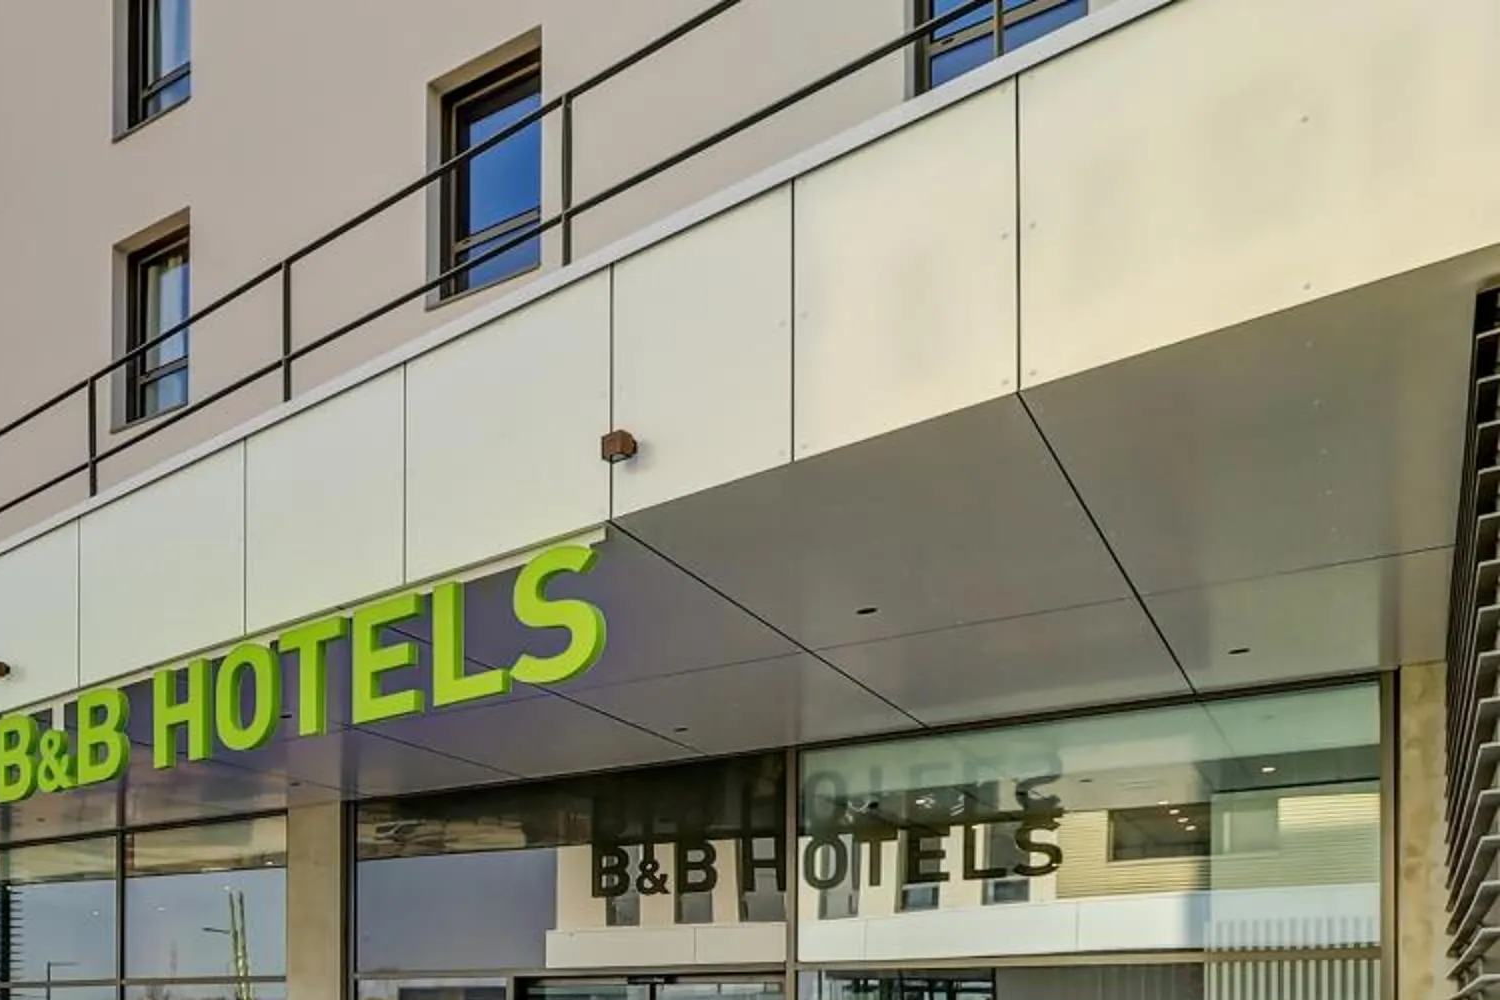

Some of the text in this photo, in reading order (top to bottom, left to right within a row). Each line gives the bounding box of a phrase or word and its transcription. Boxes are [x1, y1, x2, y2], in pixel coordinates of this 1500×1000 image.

[152, 544, 607, 770] HOTELS
[591, 823, 1063, 898] B&B HOTELS
